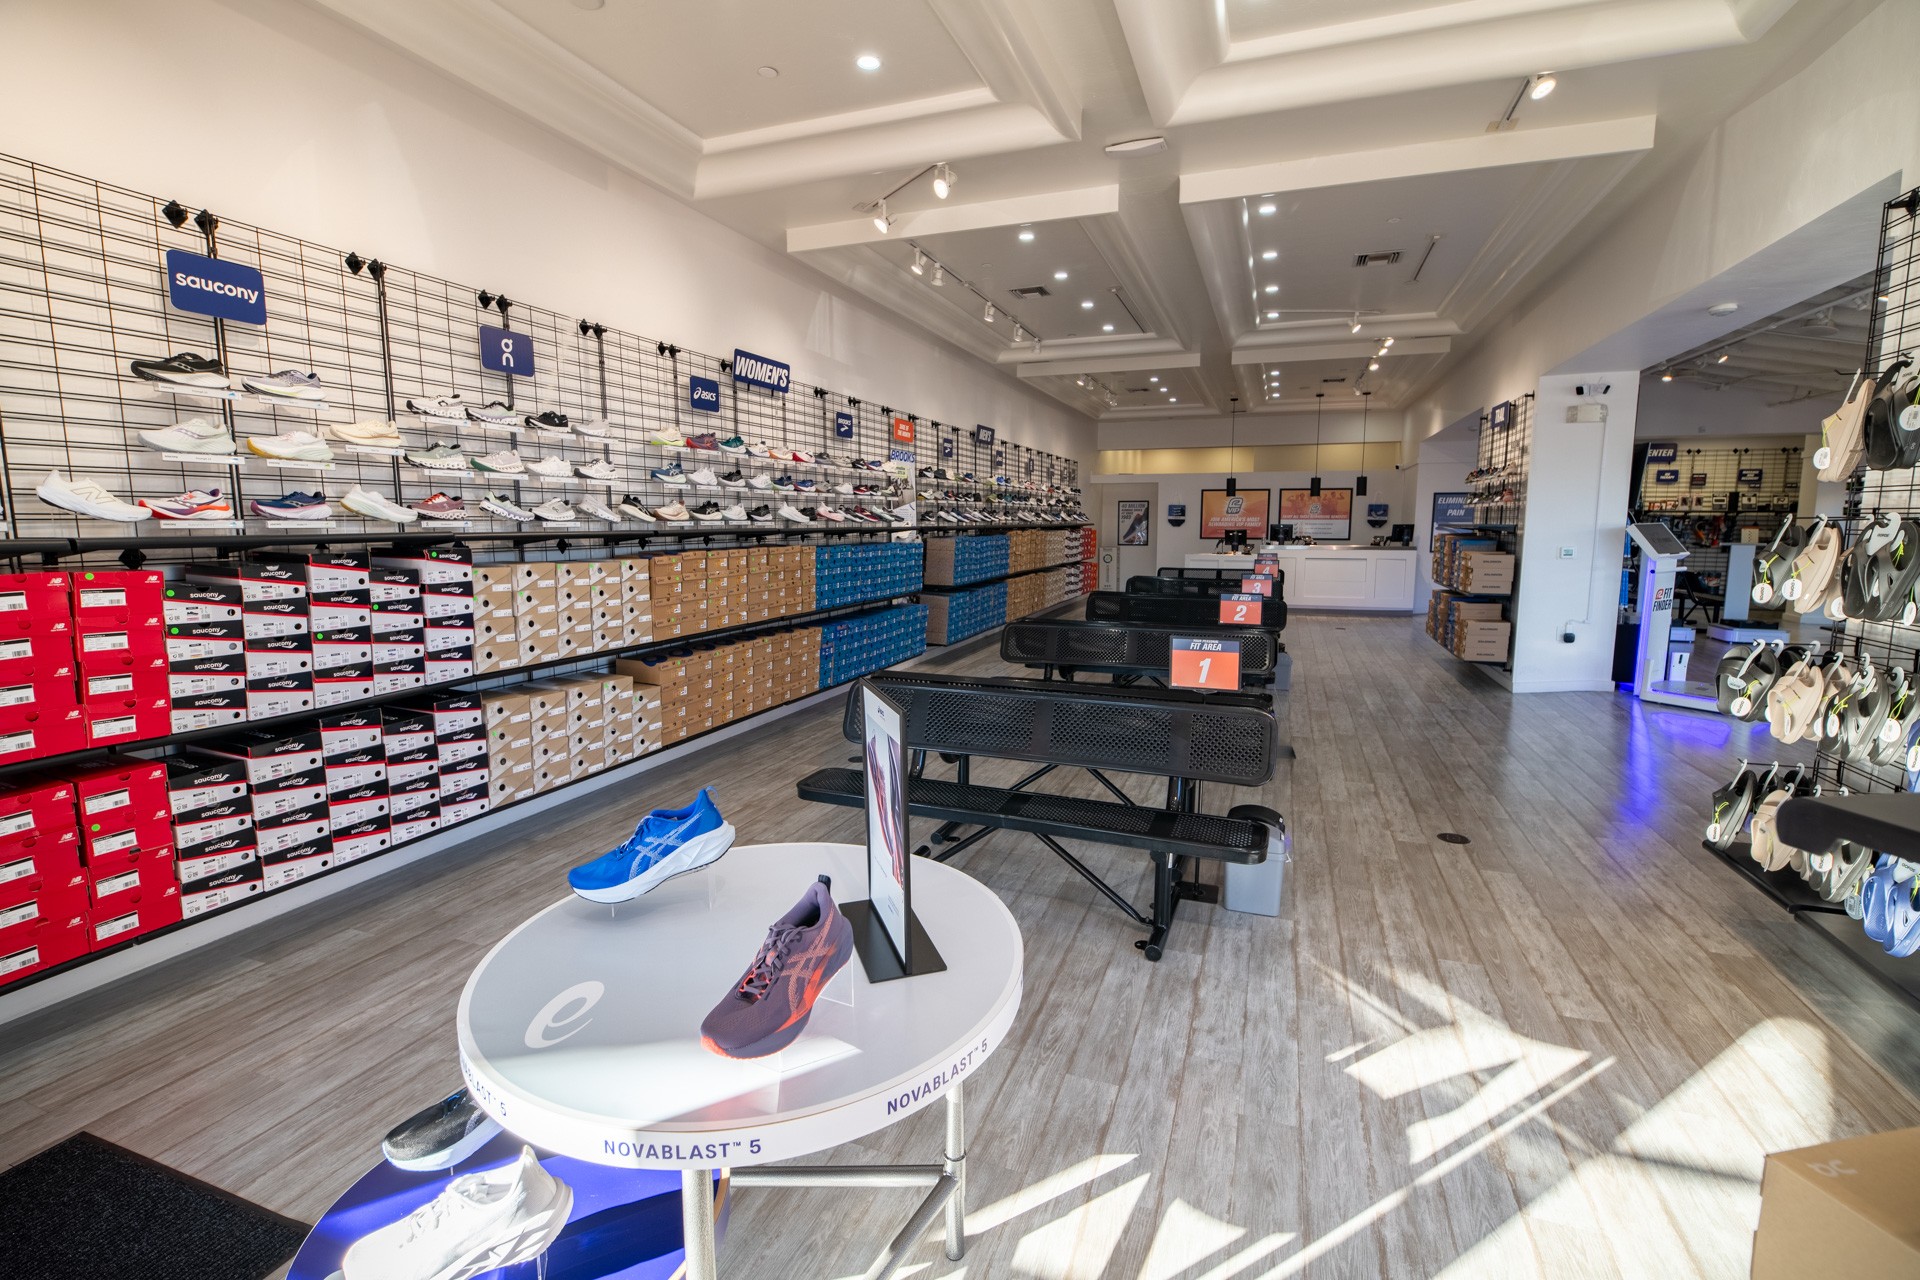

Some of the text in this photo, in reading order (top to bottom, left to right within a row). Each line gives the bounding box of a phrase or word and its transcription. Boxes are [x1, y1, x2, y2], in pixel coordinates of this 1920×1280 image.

[175, 272, 259, 304] saucony
[735, 355, 789, 388] WOMEN'S
[700, 388, 717, 401] asics
[979, 429, 992, 441] MEN'S
[890, 449, 916, 463] BROOKS
[1648, 449, 1674, 457] ENTER
[1263, 566, 1270, 574] 4
[1252, 582, 1262, 594] 3
[1664, 588, 1673, 599] FIT
[1653, 600, 1673, 612] FINDER
[1233, 605, 1247, 621] 2
[1190, 642, 1222, 651] FIT AREA
[1199, 658, 1212, 684] 1
[981, 1038, 988, 1053] 5
[501, 1102, 507, 1116] 5
[749, 1138, 762, 1154] 5
